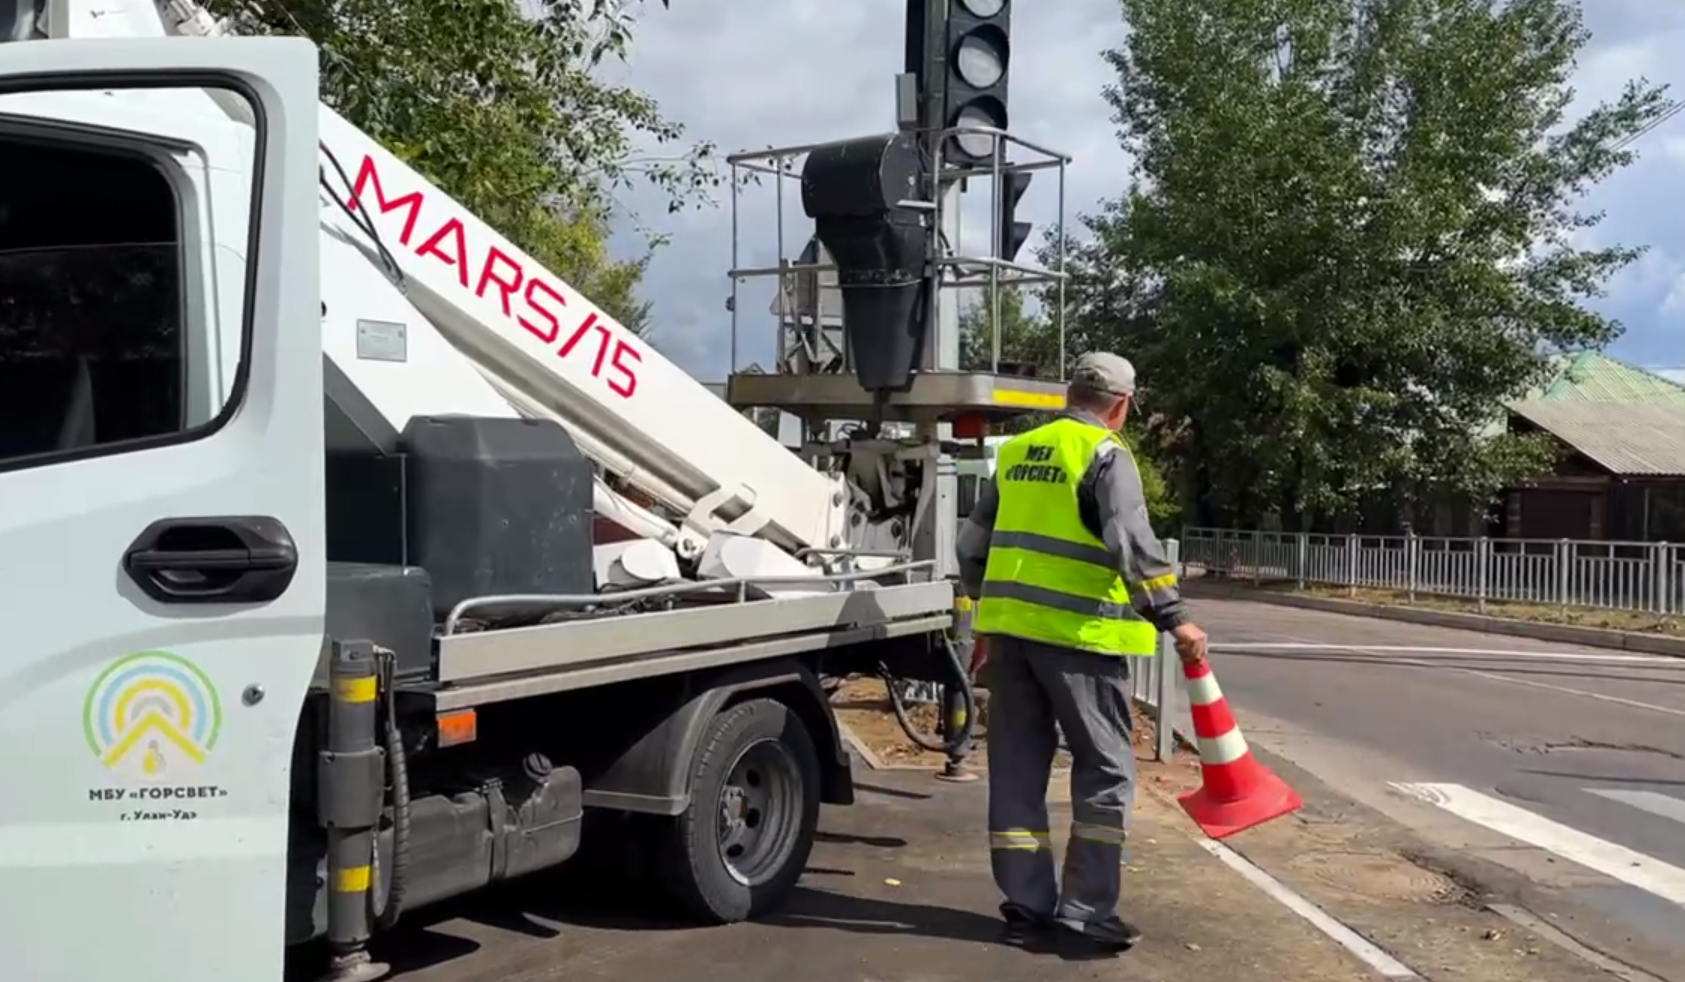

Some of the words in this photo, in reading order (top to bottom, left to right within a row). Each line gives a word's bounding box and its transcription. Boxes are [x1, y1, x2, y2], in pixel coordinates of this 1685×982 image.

[347, 153, 642, 399] MARS/15
[88, 788, 126, 801] МБУ
[129, 785, 228, 799] «ГОРСВЕТ»
[120, 812, 131, 821] г.
[133, 809, 197, 821] Улан-Удэ
